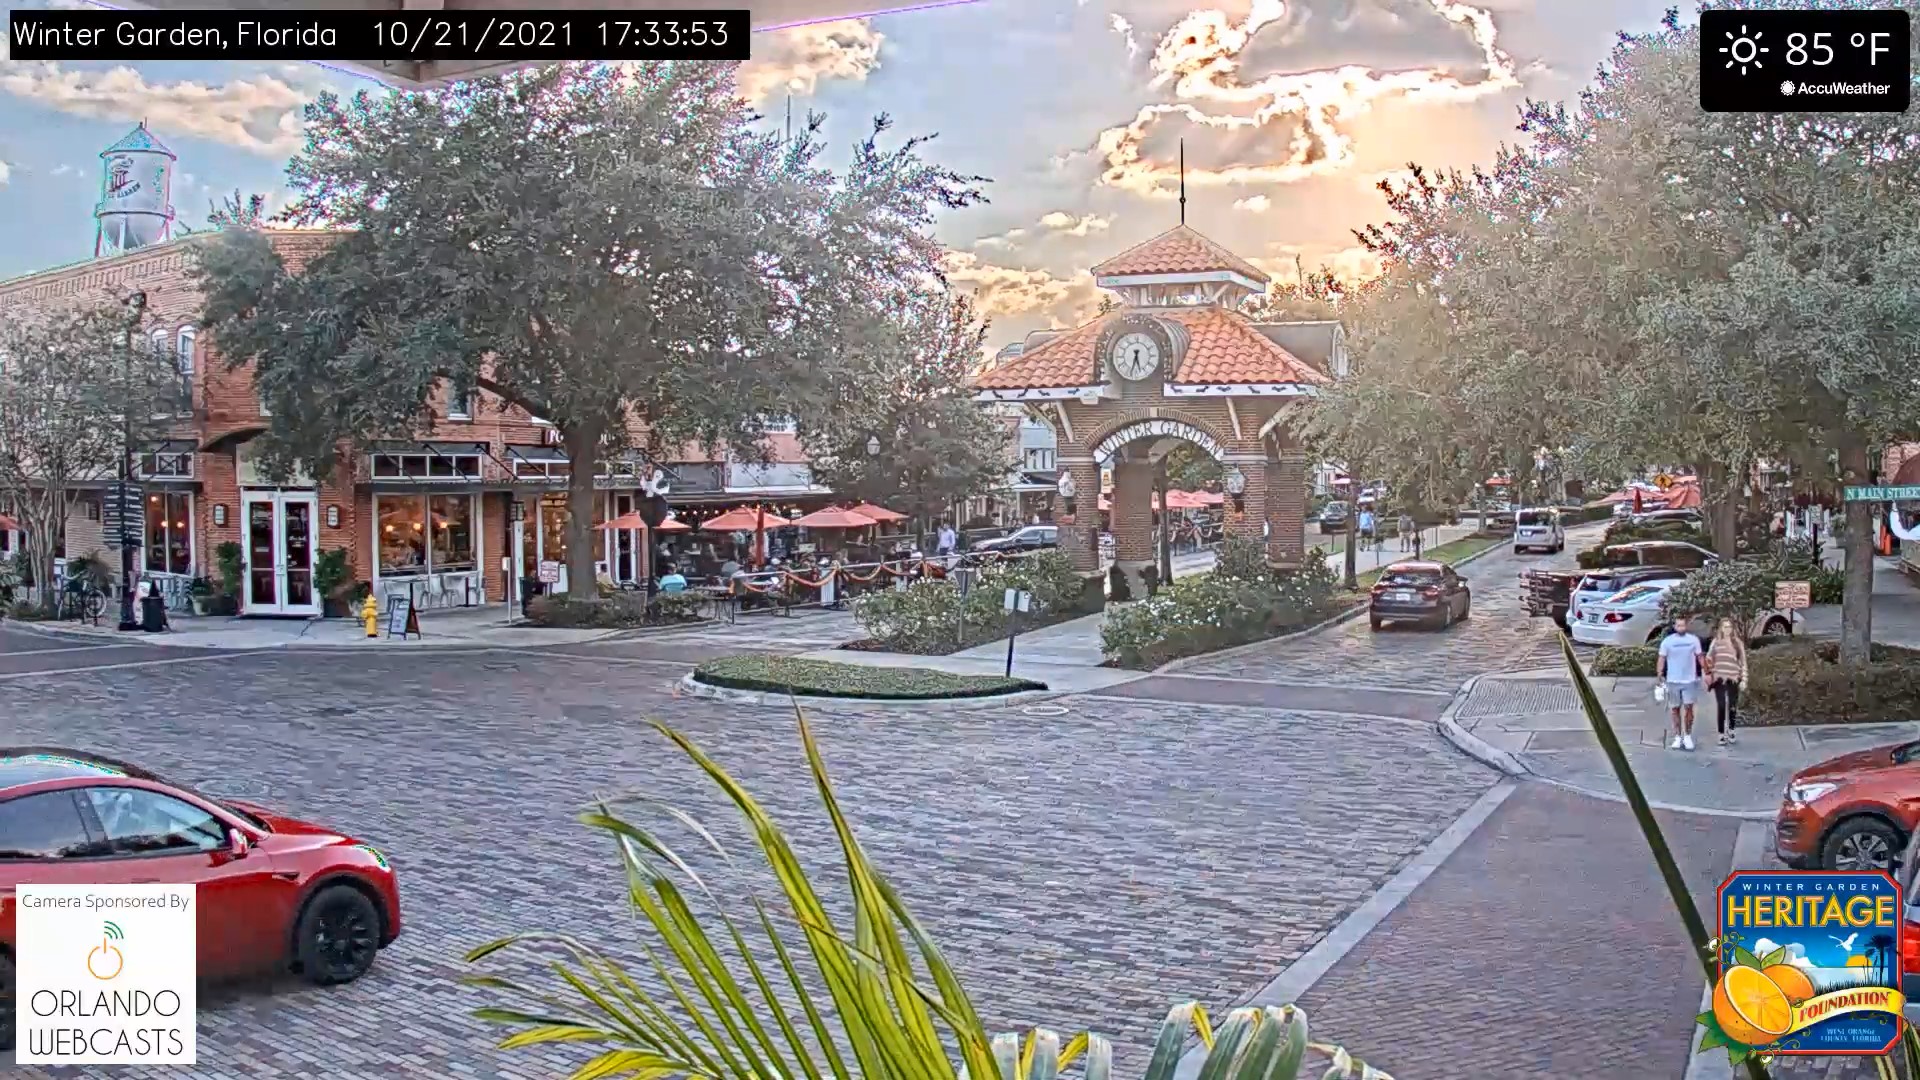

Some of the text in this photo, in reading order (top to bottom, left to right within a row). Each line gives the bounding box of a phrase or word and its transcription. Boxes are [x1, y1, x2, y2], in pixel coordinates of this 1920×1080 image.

[1099, 421, 1221, 457] WINTER GARDEN
[1847, 487, 1920, 500] N MAIN STREE
